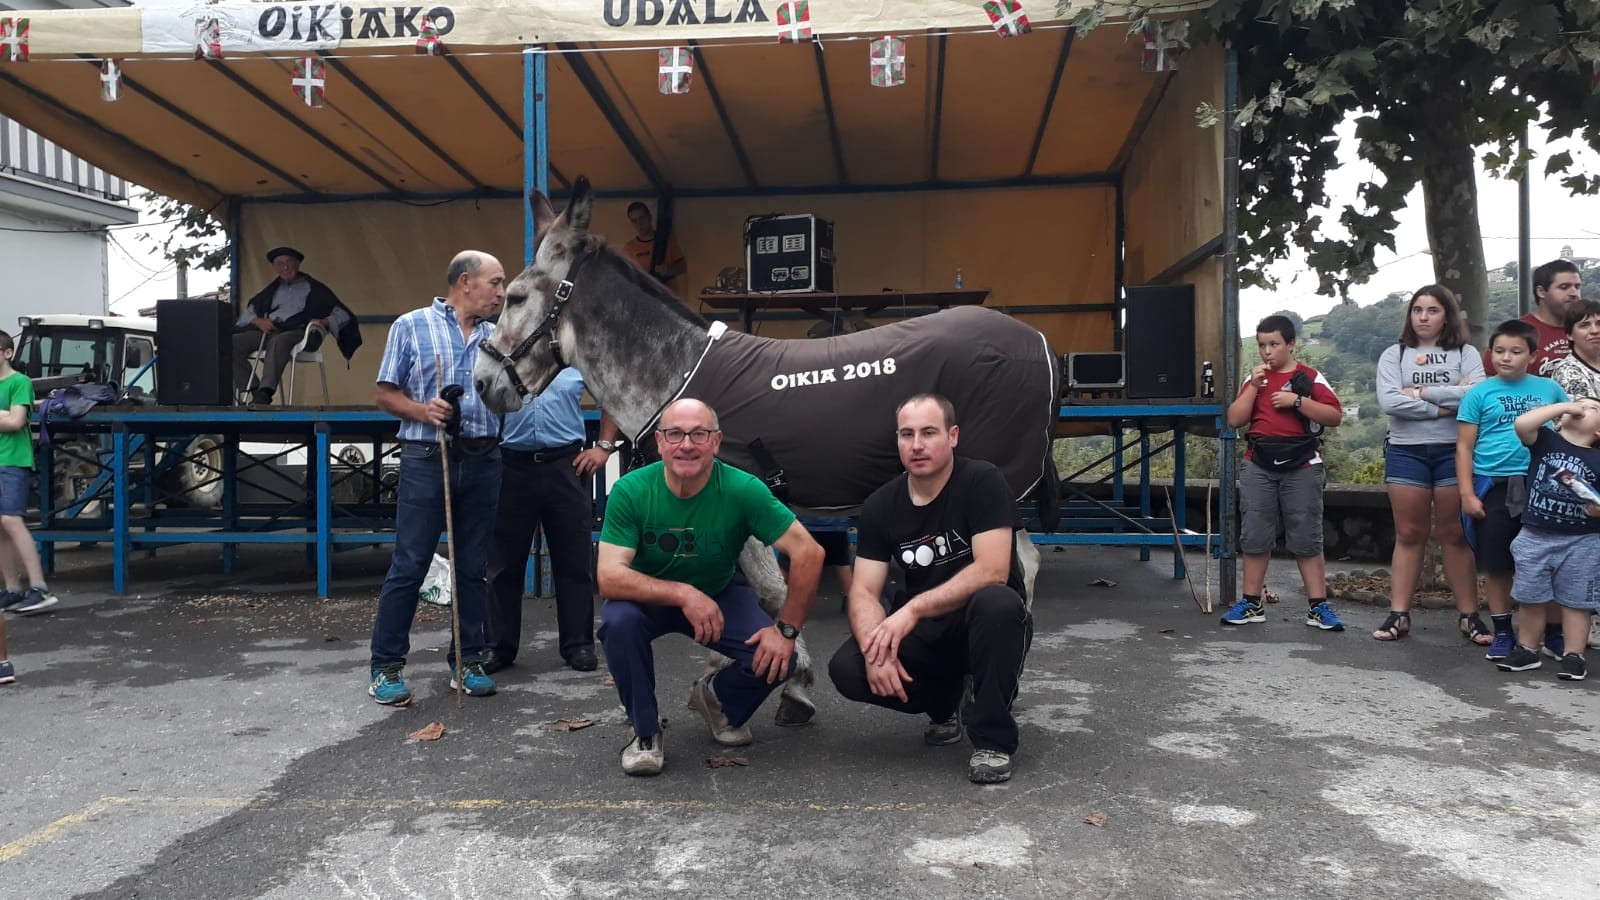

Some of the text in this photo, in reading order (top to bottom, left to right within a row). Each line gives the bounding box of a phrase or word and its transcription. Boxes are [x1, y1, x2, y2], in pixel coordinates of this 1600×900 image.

[603, 0, 770, 27] UDALA
[1416, 353, 1447, 365] NLY
[771, 357, 897, 391] OIKIA 2018
[1412, 371, 1450, 384] GIRLS
[1504, 402, 1527, 412] RACE
